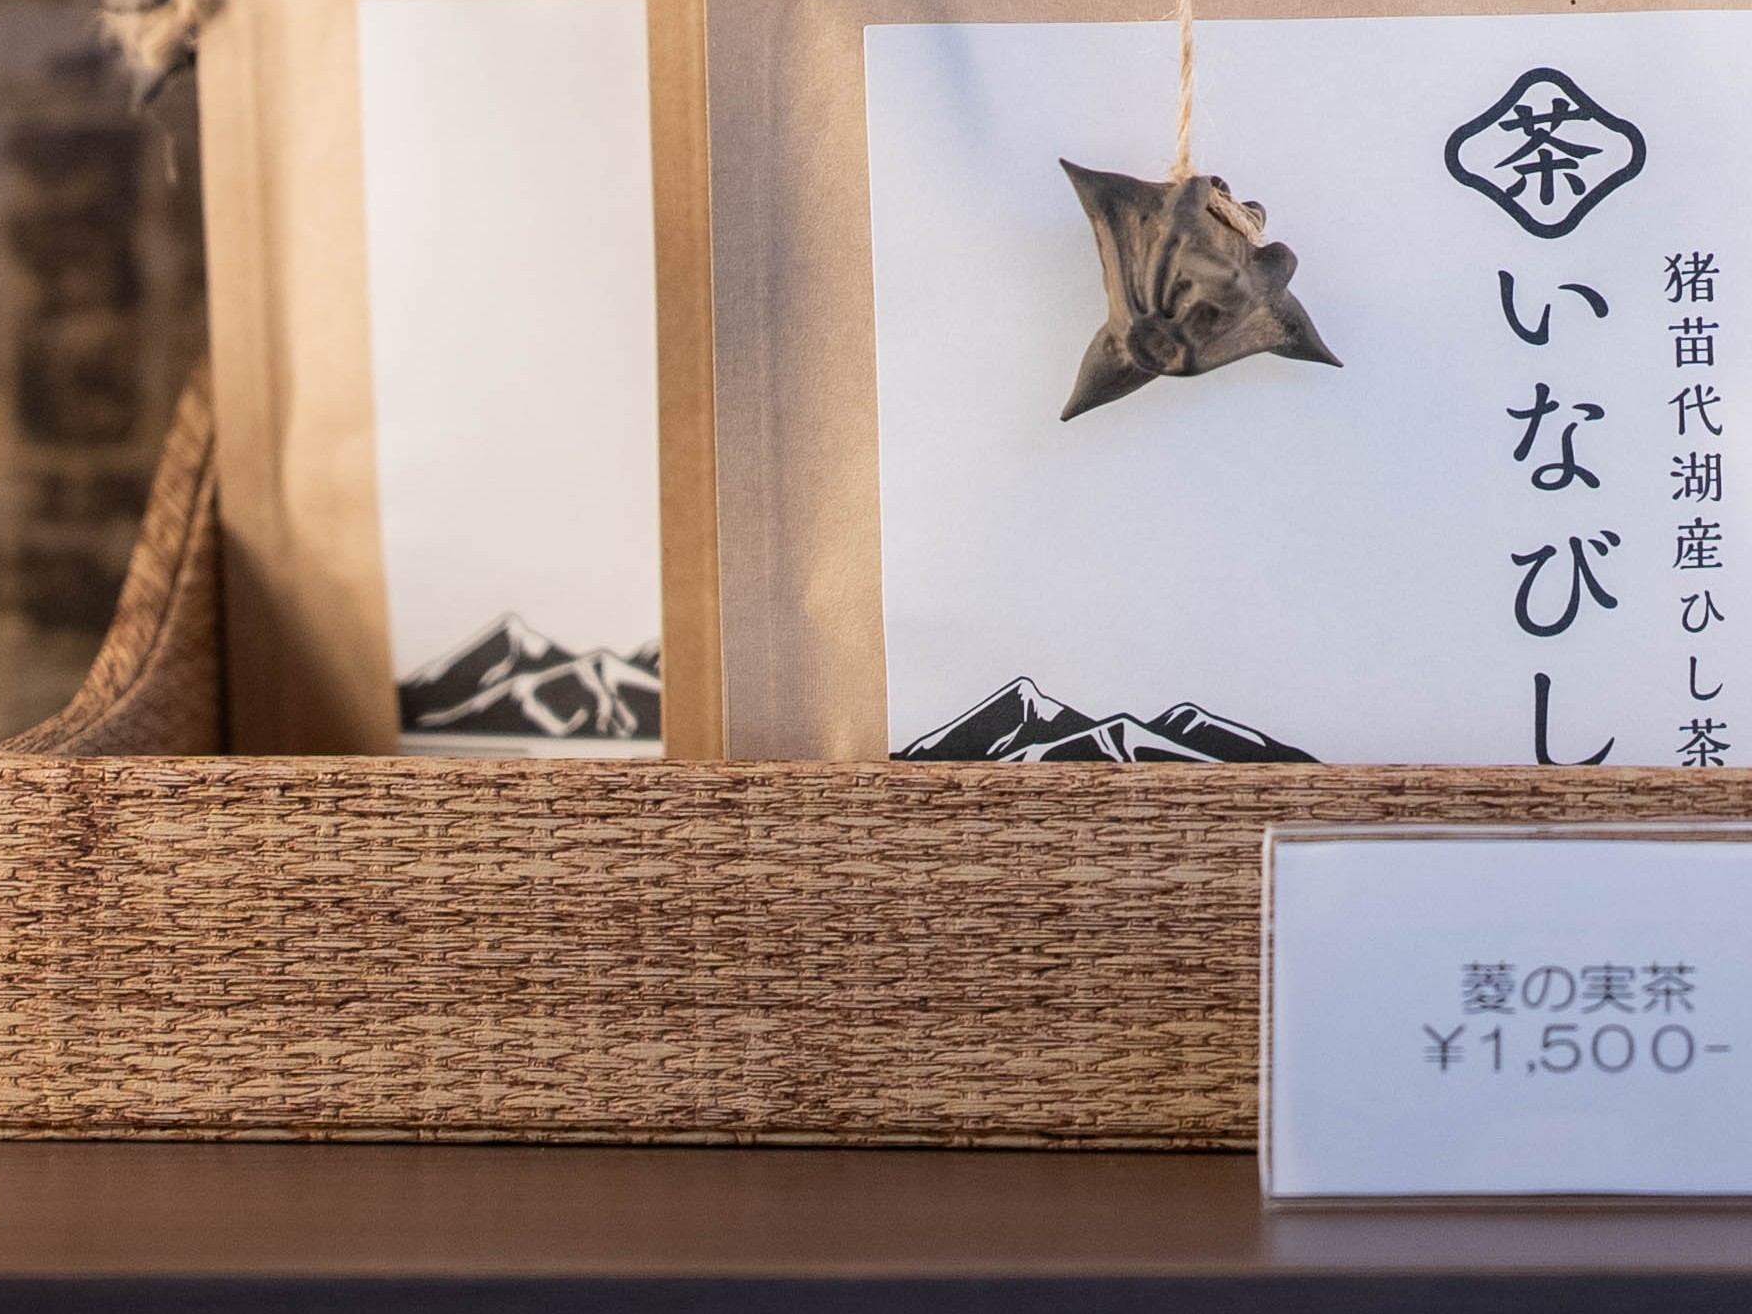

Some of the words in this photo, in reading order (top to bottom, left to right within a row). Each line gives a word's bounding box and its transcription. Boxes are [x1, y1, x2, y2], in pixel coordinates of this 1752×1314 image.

[1495, 98, 1602, 205] 茶
[1496, 269, 1621, 765] いなびし
[1663, 250, 1732, 766] 猪苗代湖産ひし茶
[1459, 959, 1698, 1017] 菱の実茶
